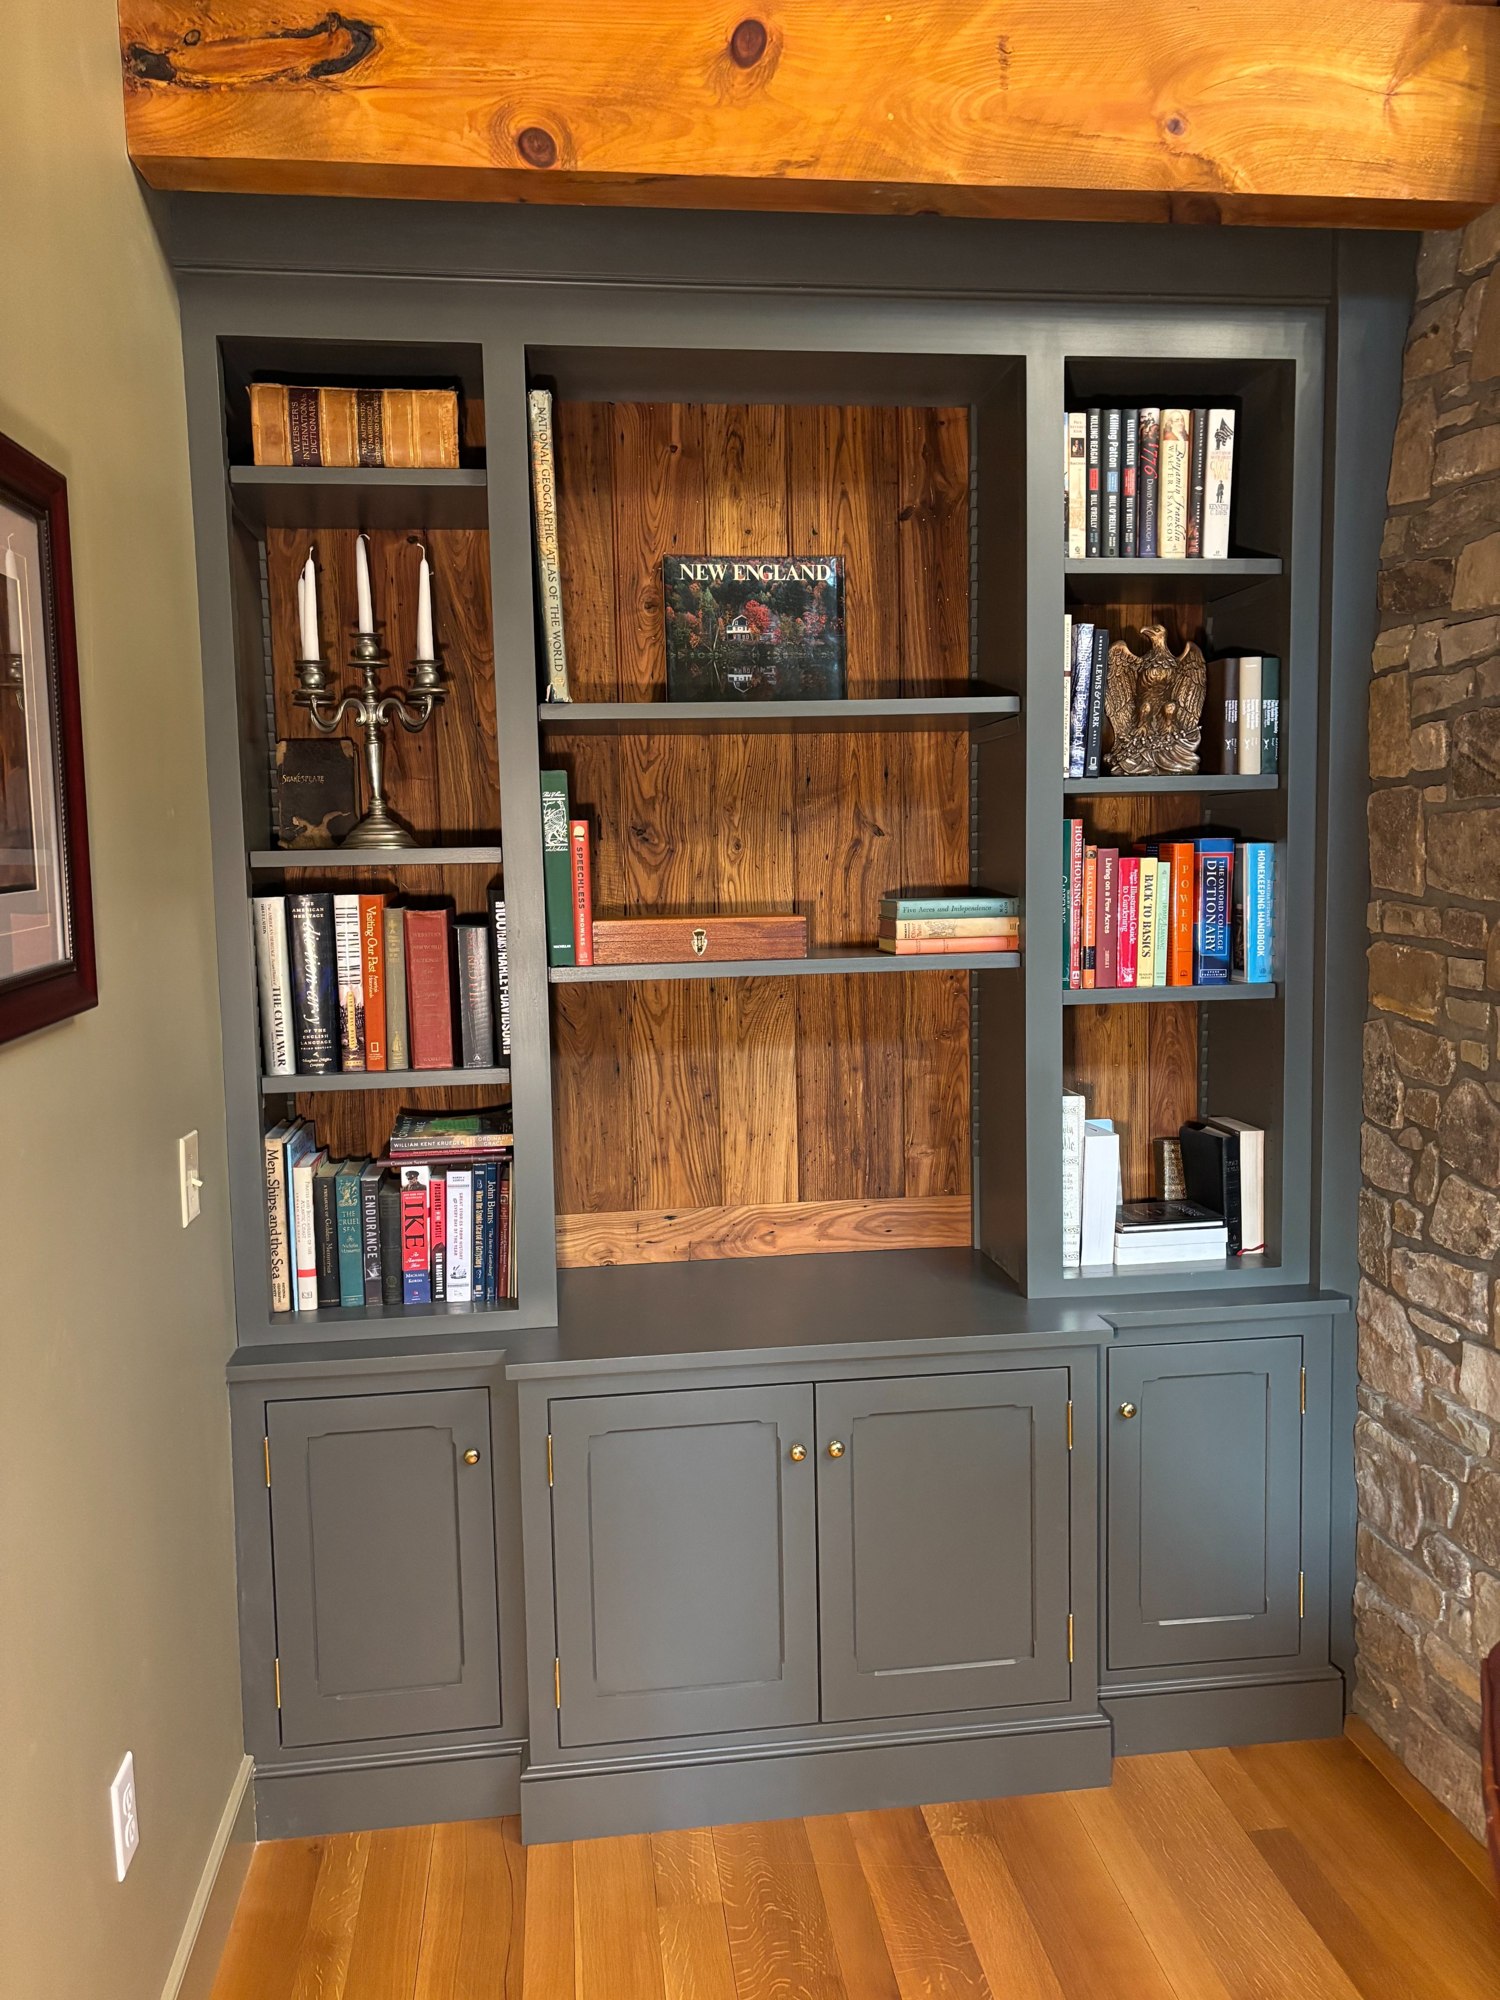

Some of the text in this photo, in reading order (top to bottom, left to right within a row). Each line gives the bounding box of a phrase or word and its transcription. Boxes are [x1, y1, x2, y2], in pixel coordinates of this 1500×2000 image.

[292, 402, 300, 452] WEBSTER'S
[309, 400, 318, 454] DICTIONARY
[538, 407, 549, 466] NATIONAL
[1090, 415, 1098, 440] KILLING
[1108, 414, 1119, 440] Killing
[1127, 419, 1135, 441] KILLING
[1090, 440, 1098, 464] REAGAN
[1109, 442, 1119, 468] Patton
[1127, 443, 1135, 465] LINCOLN
[1140, 443, 1158, 479] 1776
[1090, 494, 1098, 506] BILL
[1172, 444, 1187, 542] Benjamin Franklin
[541, 469, 554, 544] GEOGRAPHIC
[1090, 507, 1098, 528] O'REILLY
[546, 549, 557, 582] ATLAS
[680, 564, 831, 580] NEW ENGLAND
[548, 586, 558, 600] OF
[550, 604, 560, 627] THE
[552, 630, 563, 672] WORLD
[1094, 664, 1103, 689] LEWIS
[1076, 694, 1086, 720] Before
[1094, 691, 1102, 699] &
[1092, 700, 1102, 728] CLARK
[1074, 722, 1084, 737] and
[576, 847, 585, 910] SPEECHLESS
[1074, 826, 1082, 906] HORSE HOUSING
[1104, 858, 1112, 880] Living
[1086, 866, 1094, 906] BACKYARD
[1104, 882, 1110, 890] on
[1179, 865, 1190, 932] POWER
[951, 905, 992, 914] Independence
[1120, 886, 1129, 932] to Gardening
[1142, 874, 1153, 958] BACK TO BASICS
[1205, 860, 1216, 952] DICTIONARY
[336, 906, 360, 986] THE CIVIL WAR
[365, 906, 378, 972] Visiting Our Past
[1257, 911, 1265, 957] HANDBOOK
[272, 986, 286, 1067] THE CIVIL WAR
[434, 1184, 442, 1210] PRISONERS
[487, 1180, 496, 1199] John
[270, 1215, 281, 1236] and
[404, 1202, 424, 1249] IKE
[487, 1201, 495, 1224] Burns
[325, 1218, 333, 1242] Golden
[364, 1195, 378, 1258] ENDURANCE
[272, 1238, 282, 1257] the
[474, 1246, 483, 1268] Gettysburg
[272, 1259, 283, 1279] Sea
